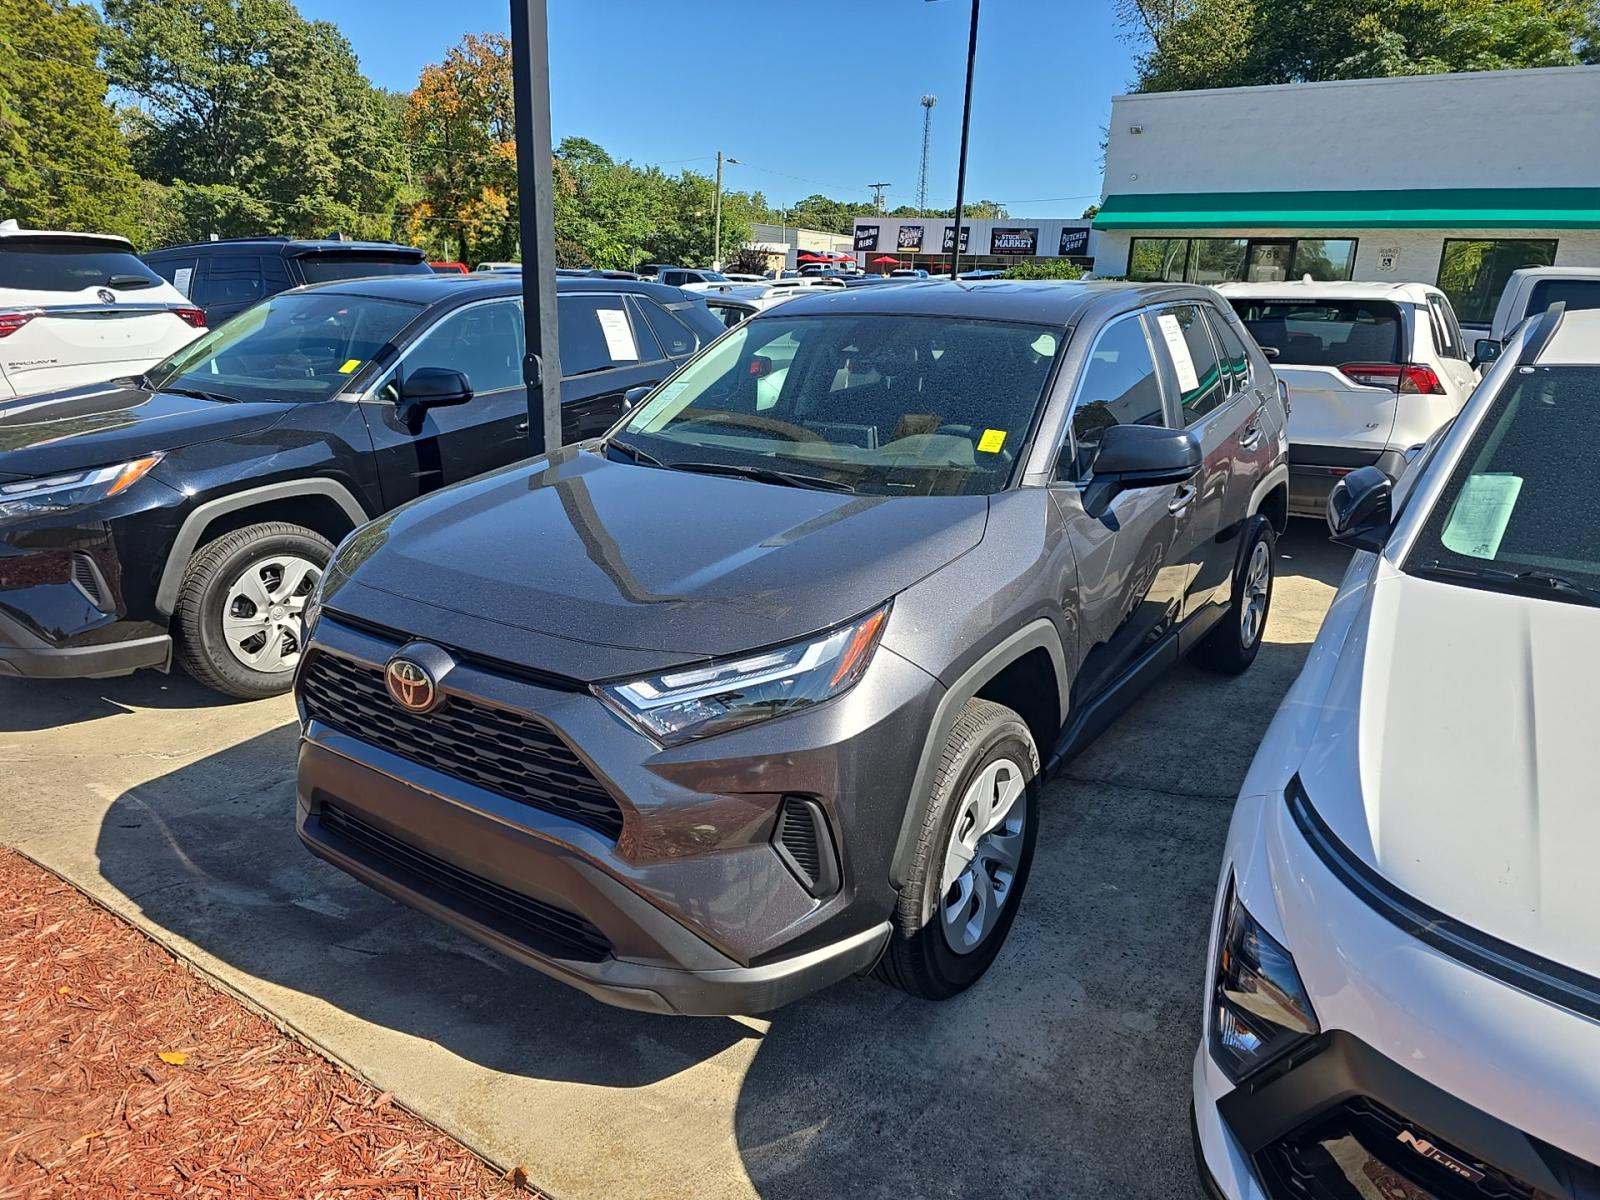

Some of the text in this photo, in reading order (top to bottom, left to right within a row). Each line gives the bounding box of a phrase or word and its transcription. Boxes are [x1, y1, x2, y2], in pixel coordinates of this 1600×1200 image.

[858, 238, 873, 248] RIBS
[1061, 231, 1087, 245] BUTCHER
[994, 239, 1033, 248] MARKET
[1260, 249, 1280, 259] 788
[8, 359, 58, 367] ENCLAVE
[1433, 1154, 1471, 1178] Line
